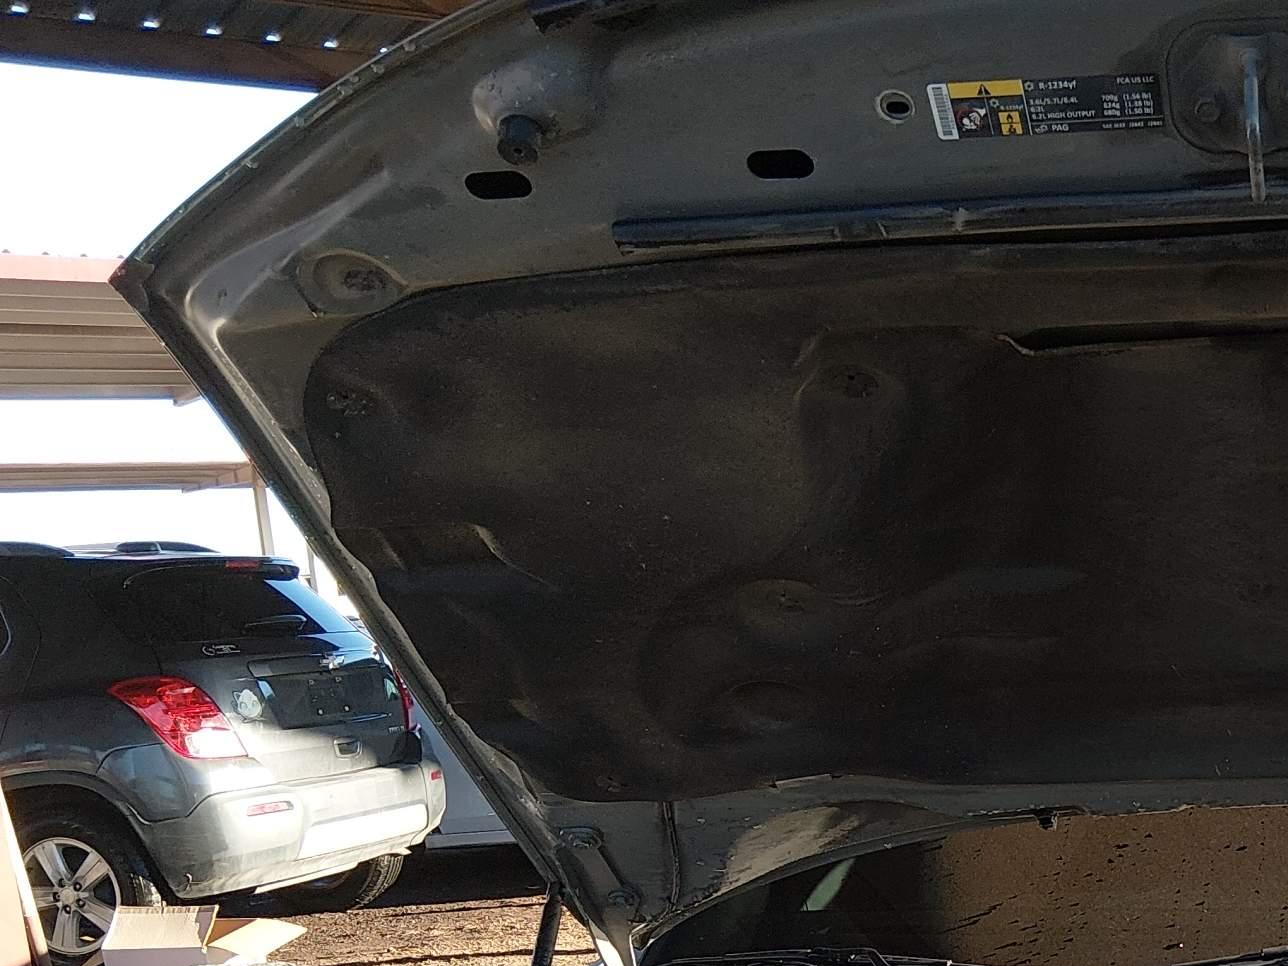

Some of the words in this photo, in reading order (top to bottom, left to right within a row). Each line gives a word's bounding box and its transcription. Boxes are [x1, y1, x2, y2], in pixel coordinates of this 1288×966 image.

[1132, 76, 1142, 84] US
[1142, 75, 1154, 83] LLC
[1038, 80, 1077, 91] R-1234yf
[1047, 111, 1066, 119] HIGH
[1067, 110, 1096, 119] OUTPUT
[1051, 123, 1069, 132] PAG
